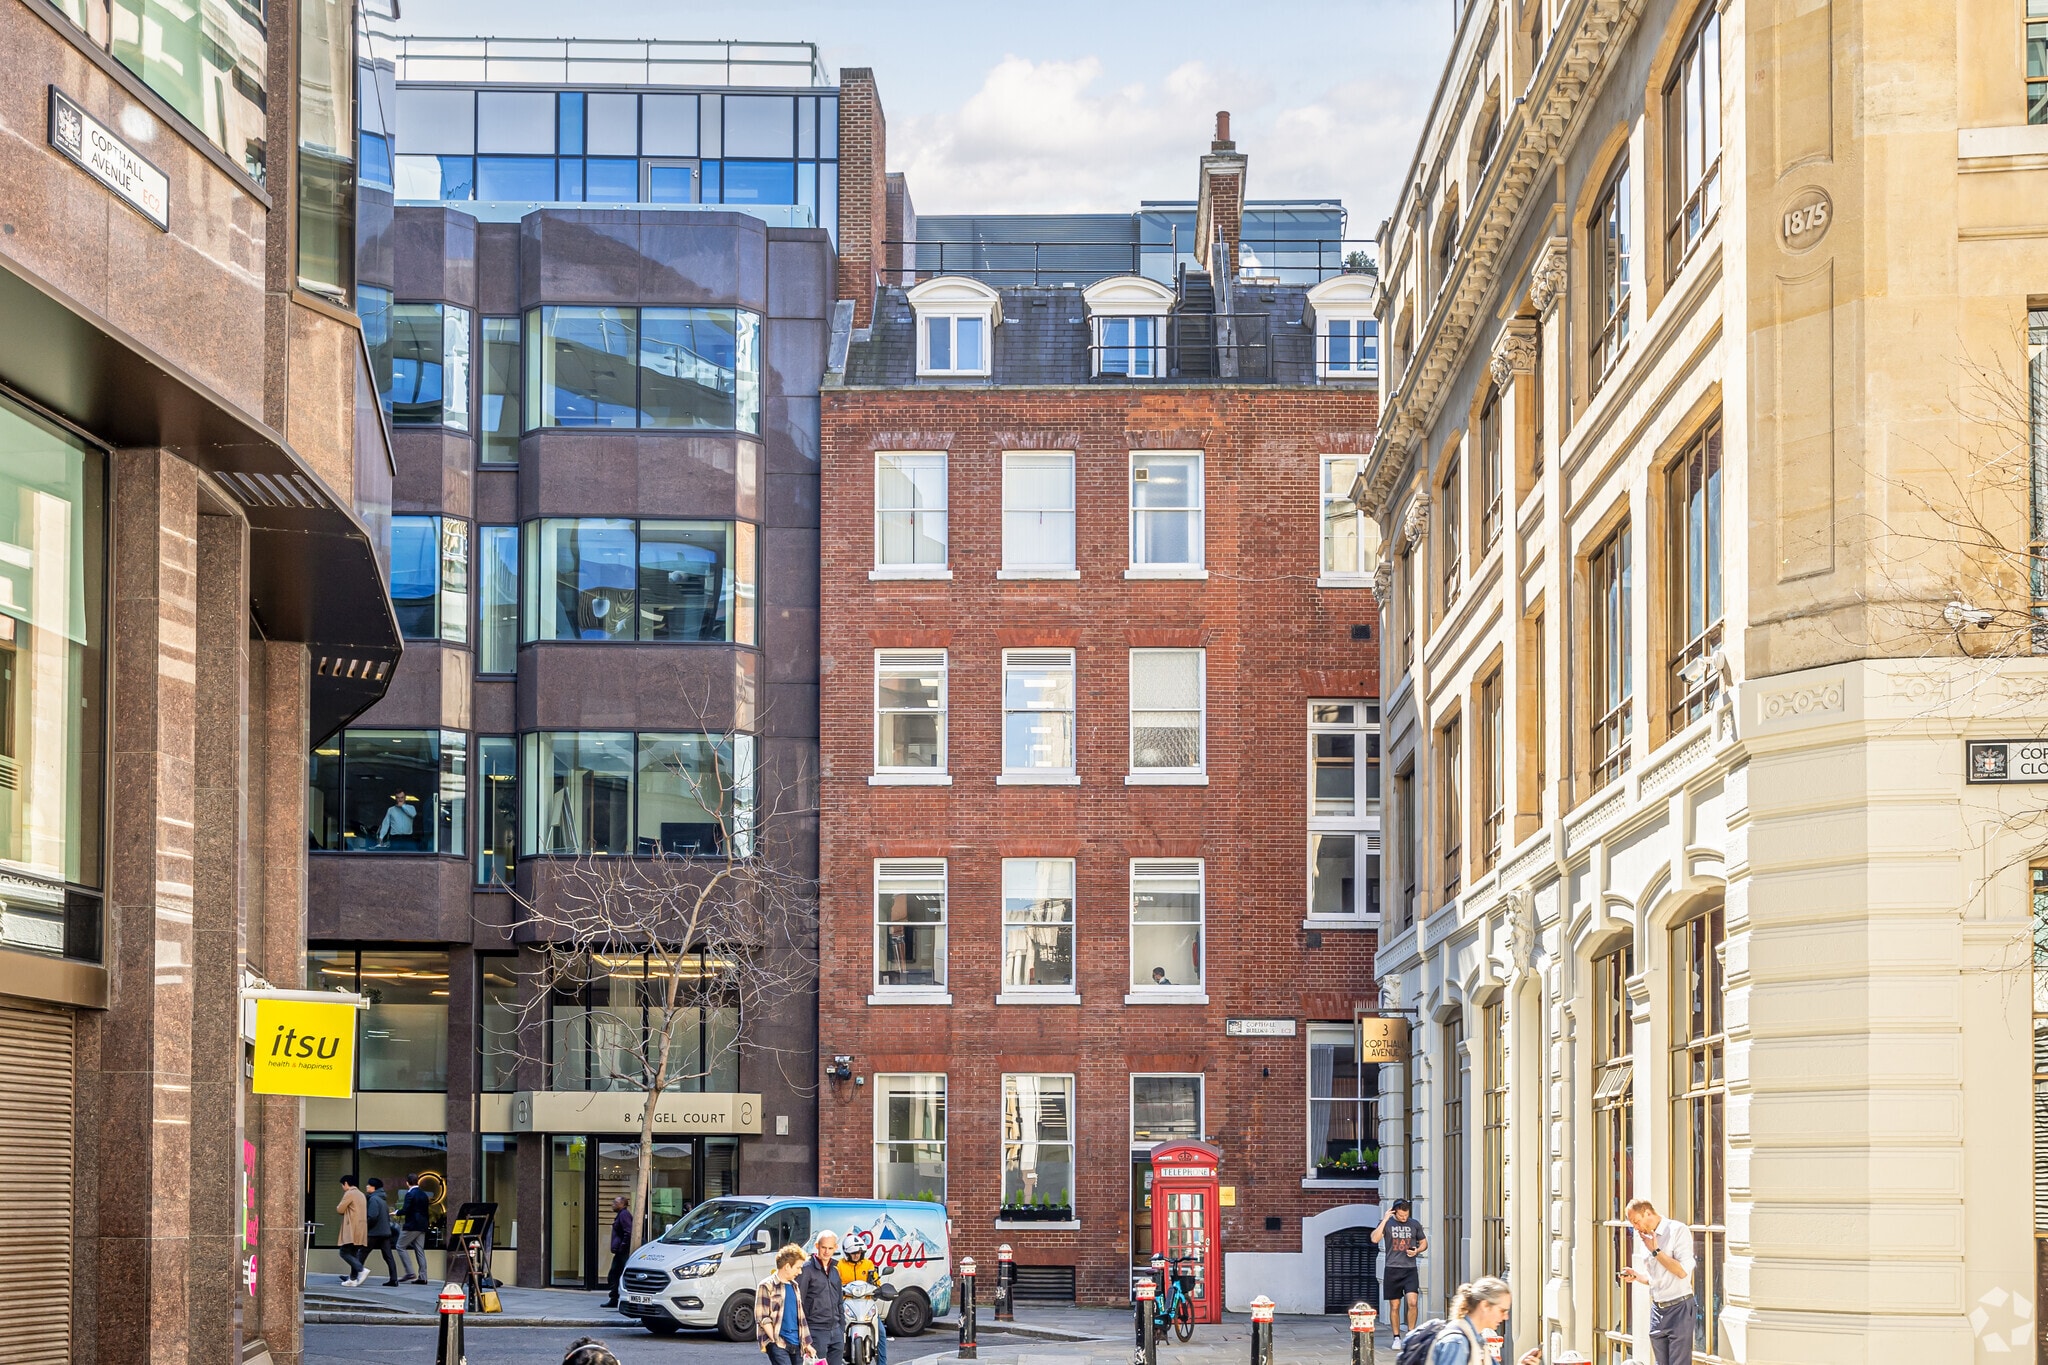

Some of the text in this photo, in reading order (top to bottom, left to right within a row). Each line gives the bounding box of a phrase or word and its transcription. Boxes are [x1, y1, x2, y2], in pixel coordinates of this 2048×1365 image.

[91, 130, 144, 182] COPTHALL
[91, 152, 160, 214] AVENUE EC2
[1784, 202, 1827, 238] 1875
[1382, 1023, 1389, 1036] 3
[271, 1025, 340, 1060] itsu
[1371, 1048, 1400, 1057] AVENUE
[268, 1060, 290, 1068] health
[298, 1062, 333, 1071] happiness
[624, 1113, 726, 1123] 8 AGEL COURT
[1163, 1168, 1208, 1176] TELEPHONE
